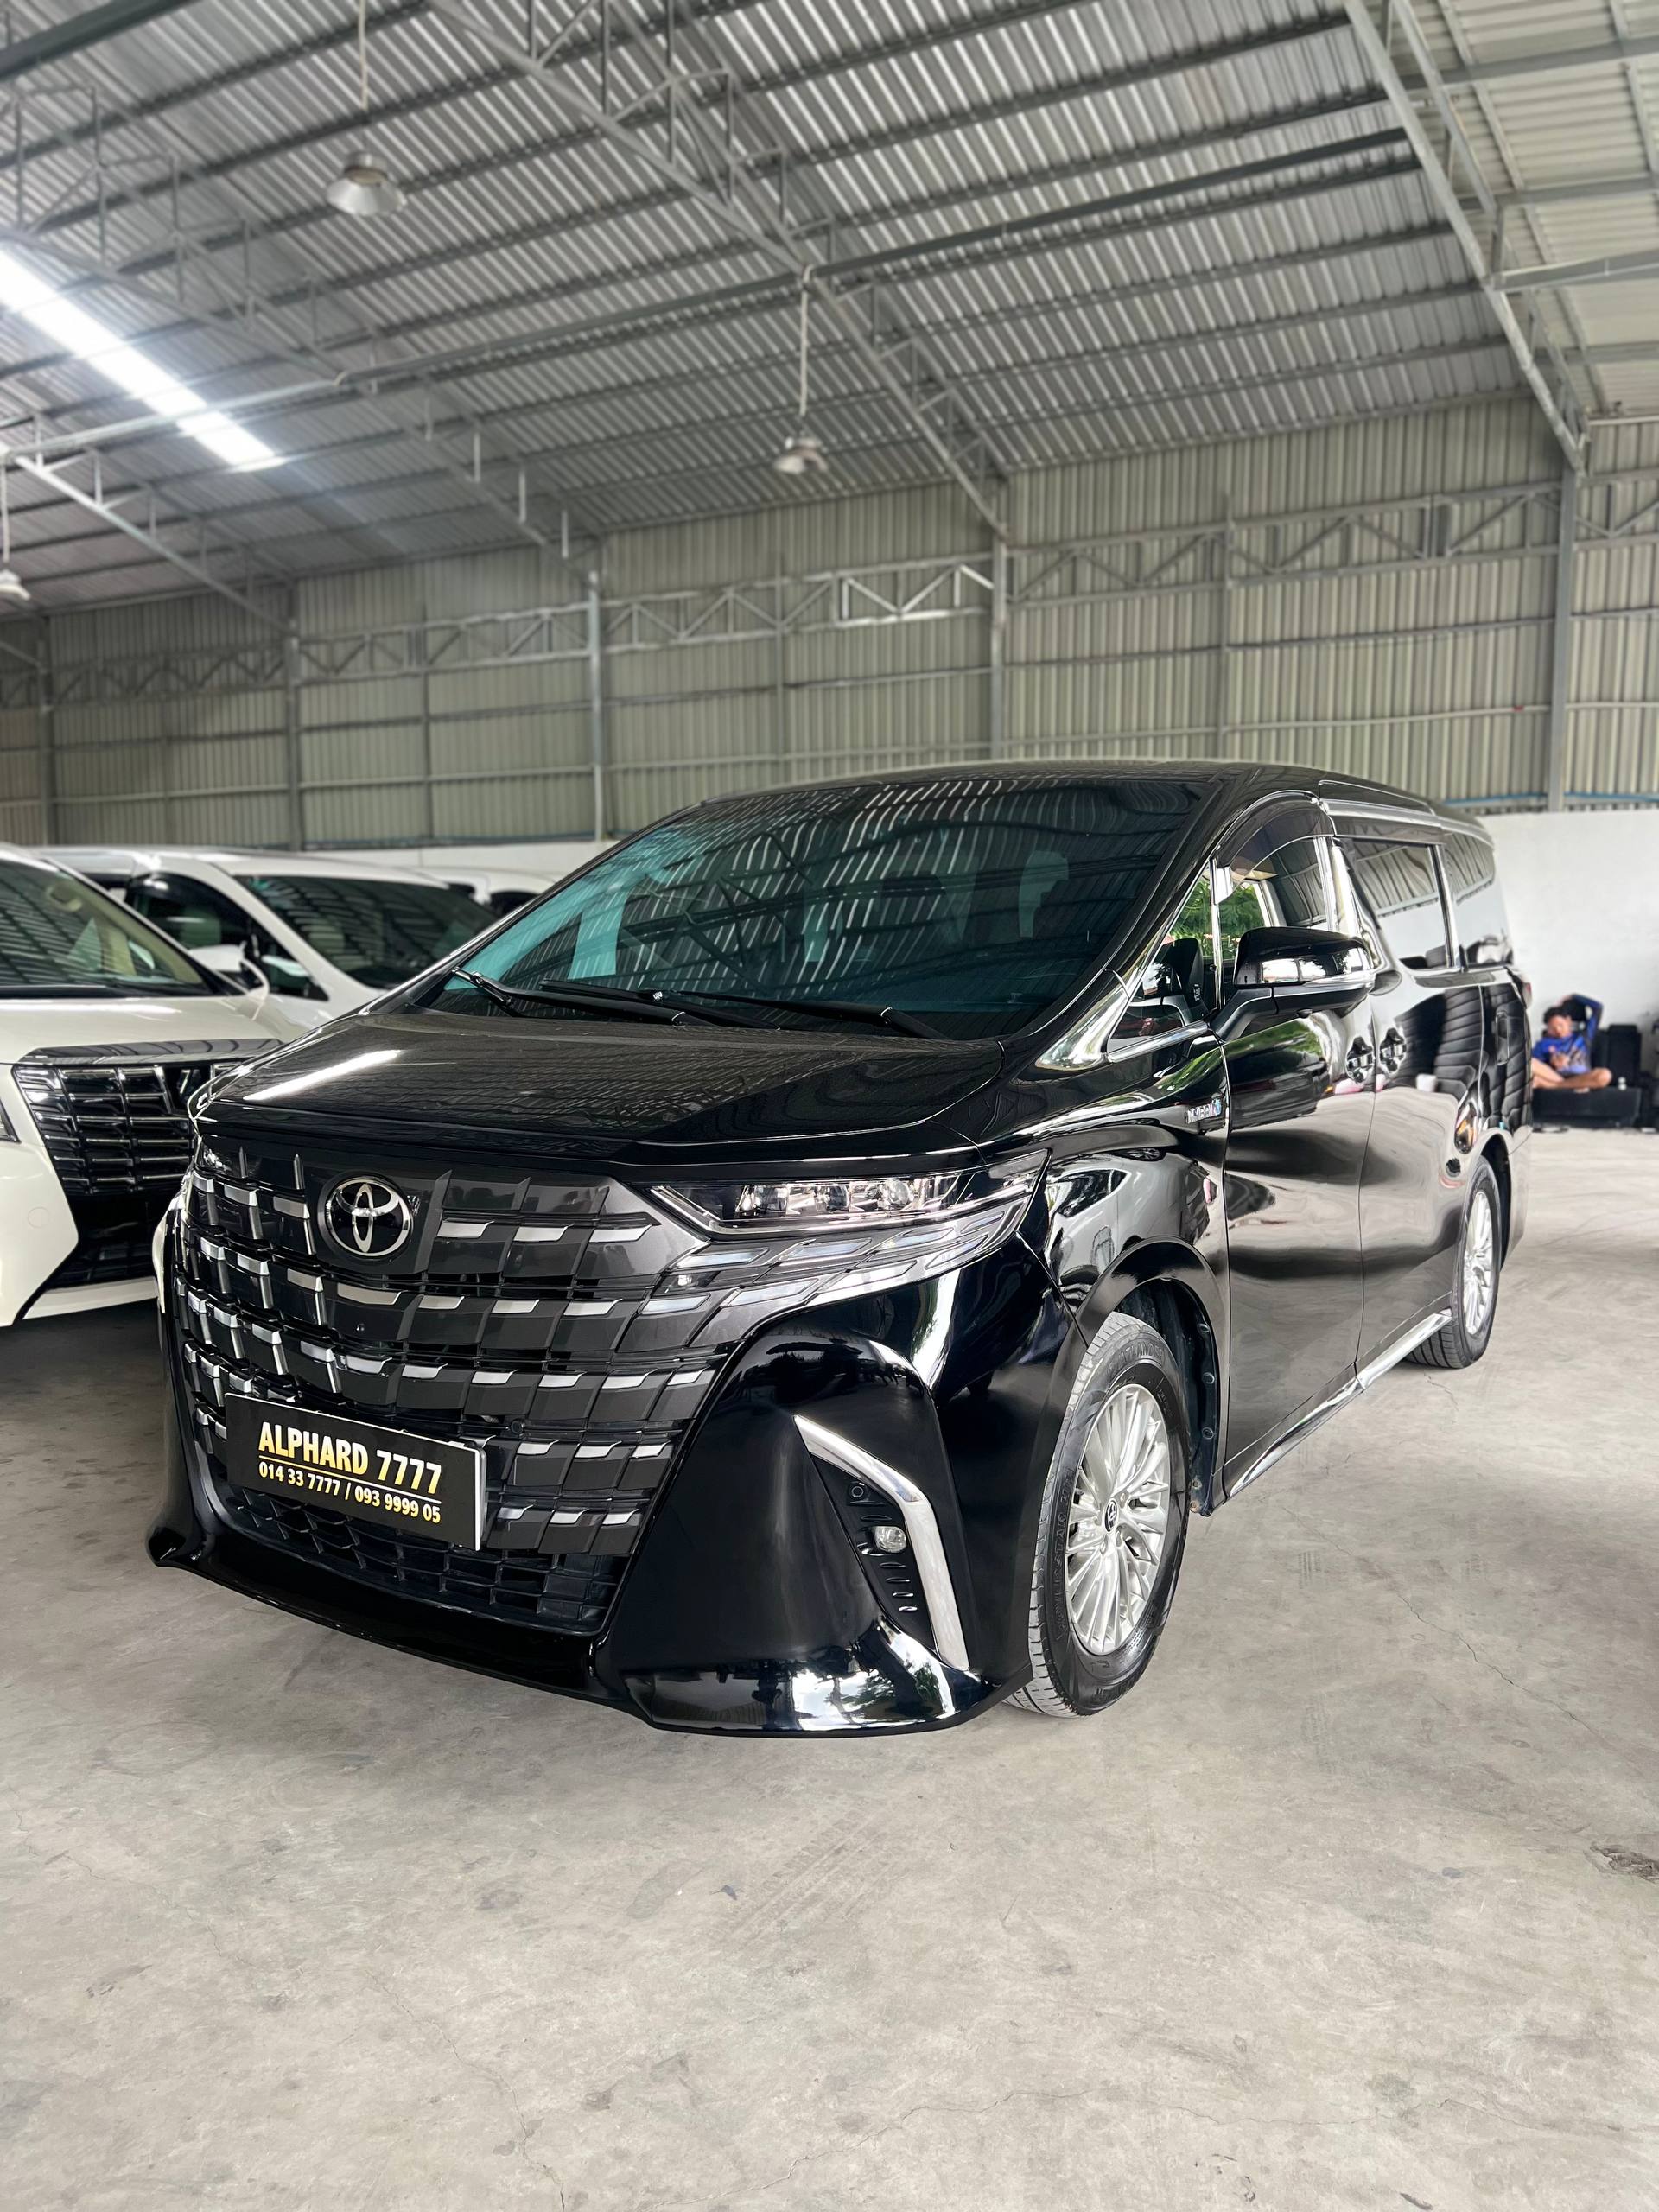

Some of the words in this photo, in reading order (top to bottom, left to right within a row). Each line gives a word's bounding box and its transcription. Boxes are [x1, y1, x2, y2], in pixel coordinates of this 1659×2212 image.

[258, 1421, 369, 1475] ALPHARD
[376, 1450, 442, 1494] 7777
[258, 1461, 284, 1482] 014
[287, 1471, 304, 1487] 33
[307, 1473, 341, 1496] 7777
[345, 1483, 352, 1500] /
[354, 1485, 381, 1507] 093
[384, 1496, 419, 1517] 9999
[423, 1504, 442, 1523] 05
